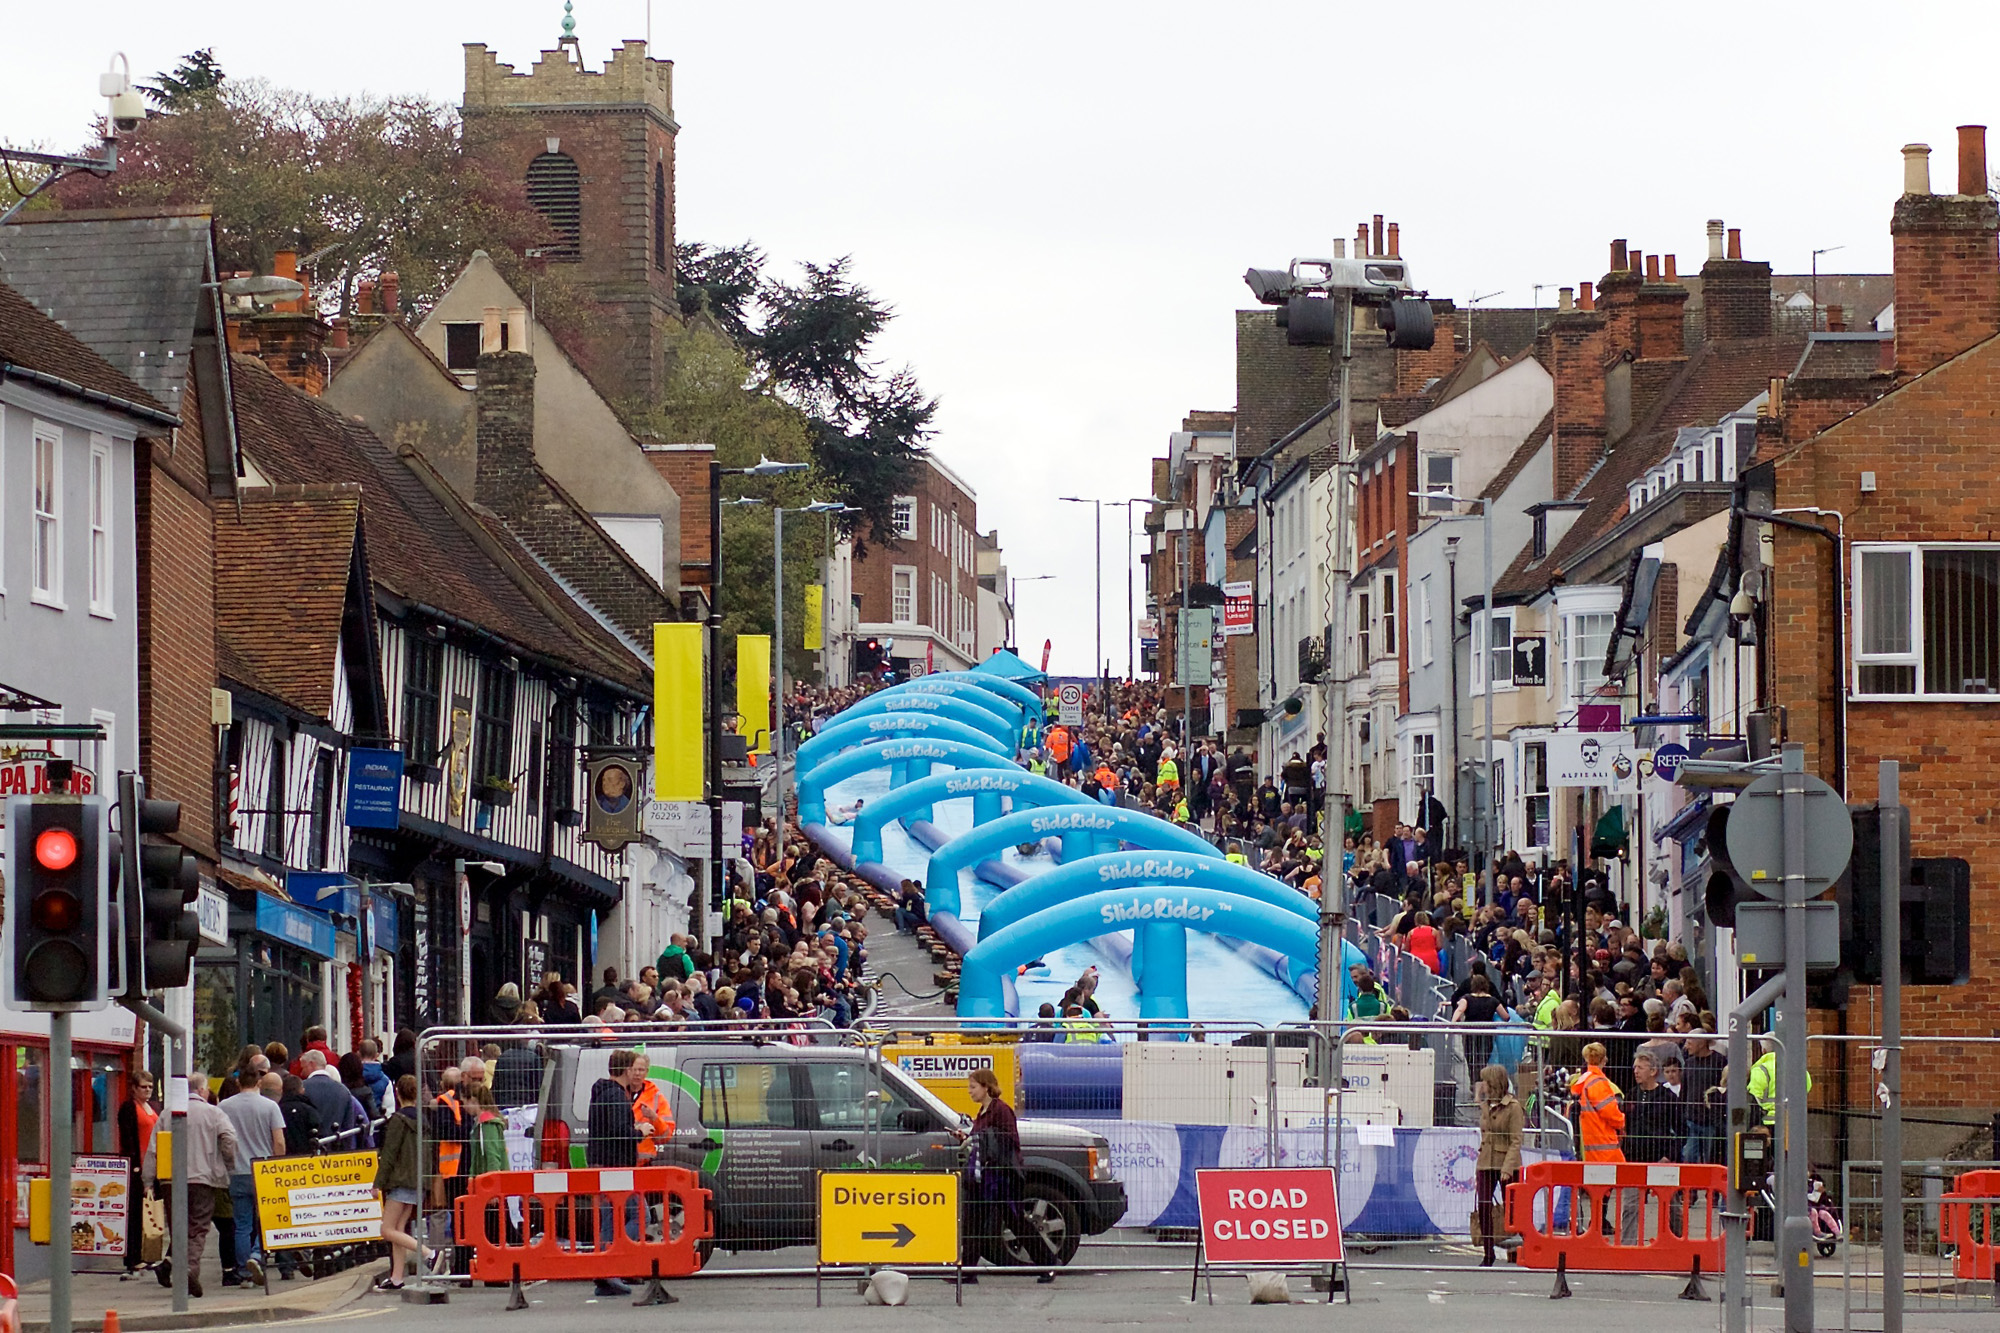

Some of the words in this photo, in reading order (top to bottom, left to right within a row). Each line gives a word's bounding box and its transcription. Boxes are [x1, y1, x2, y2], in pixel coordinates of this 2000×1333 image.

[1064, 690, 1078, 700] 20
[884, 698, 940, 712] SlideRider
[868, 717, 929, 733] SlideRider
[20, 751, 51, 759] PIZZA
[881, 744, 948, 760] SlideRider
[365, 763, 389, 771] INDIAN
[31, 765, 91, 794] JON'S
[946, 775, 1019, 794] SlideRider
[354, 783, 394, 792] RESTAURANT
[652, 803, 679, 811] 01206
[650, 812, 681, 820] 762295
[1031, 812, 1115, 833] SlideRider
[1098, 860, 1195, 882] SlideRider
[1100, 897, 1214, 924] SlideRider
[1775, 1011, 1783, 1022] 5
[1729, 1018, 1738, 1032] 2
[173, 1038, 182, 1050] 4
[913, 1057, 991, 1071] SELWOOD
[1110, 1142, 1151, 1154] ANCER
[1296, 1149, 1349, 1161] CANCR
[87, 1160, 107, 1168] SPECIAL
[108, 1160, 126, 1169] OFFERS
[260, 1162, 315, 1175] Advance
[320, 1156, 373, 1170] Warning
[1110, 1156, 1165, 1168] ESEARCH
[274, 1175, 307, 1188] Road
[311, 1172, 361, 1185] Closure
[261, 1196, 287, 1205] From
[834, 1187, 946, 1206] Diversion
[1228, 1188, 1308, 1210] ROAD
[276, 1213, 289, 1223] To
[273, 1232, 298, 1240] NORTH
[300, 1230, 318, 1238] HILL
[324, 1225, 369, 1236] SLIDERIDER
[1213, 1219, 1329, 1240] CLOSED
